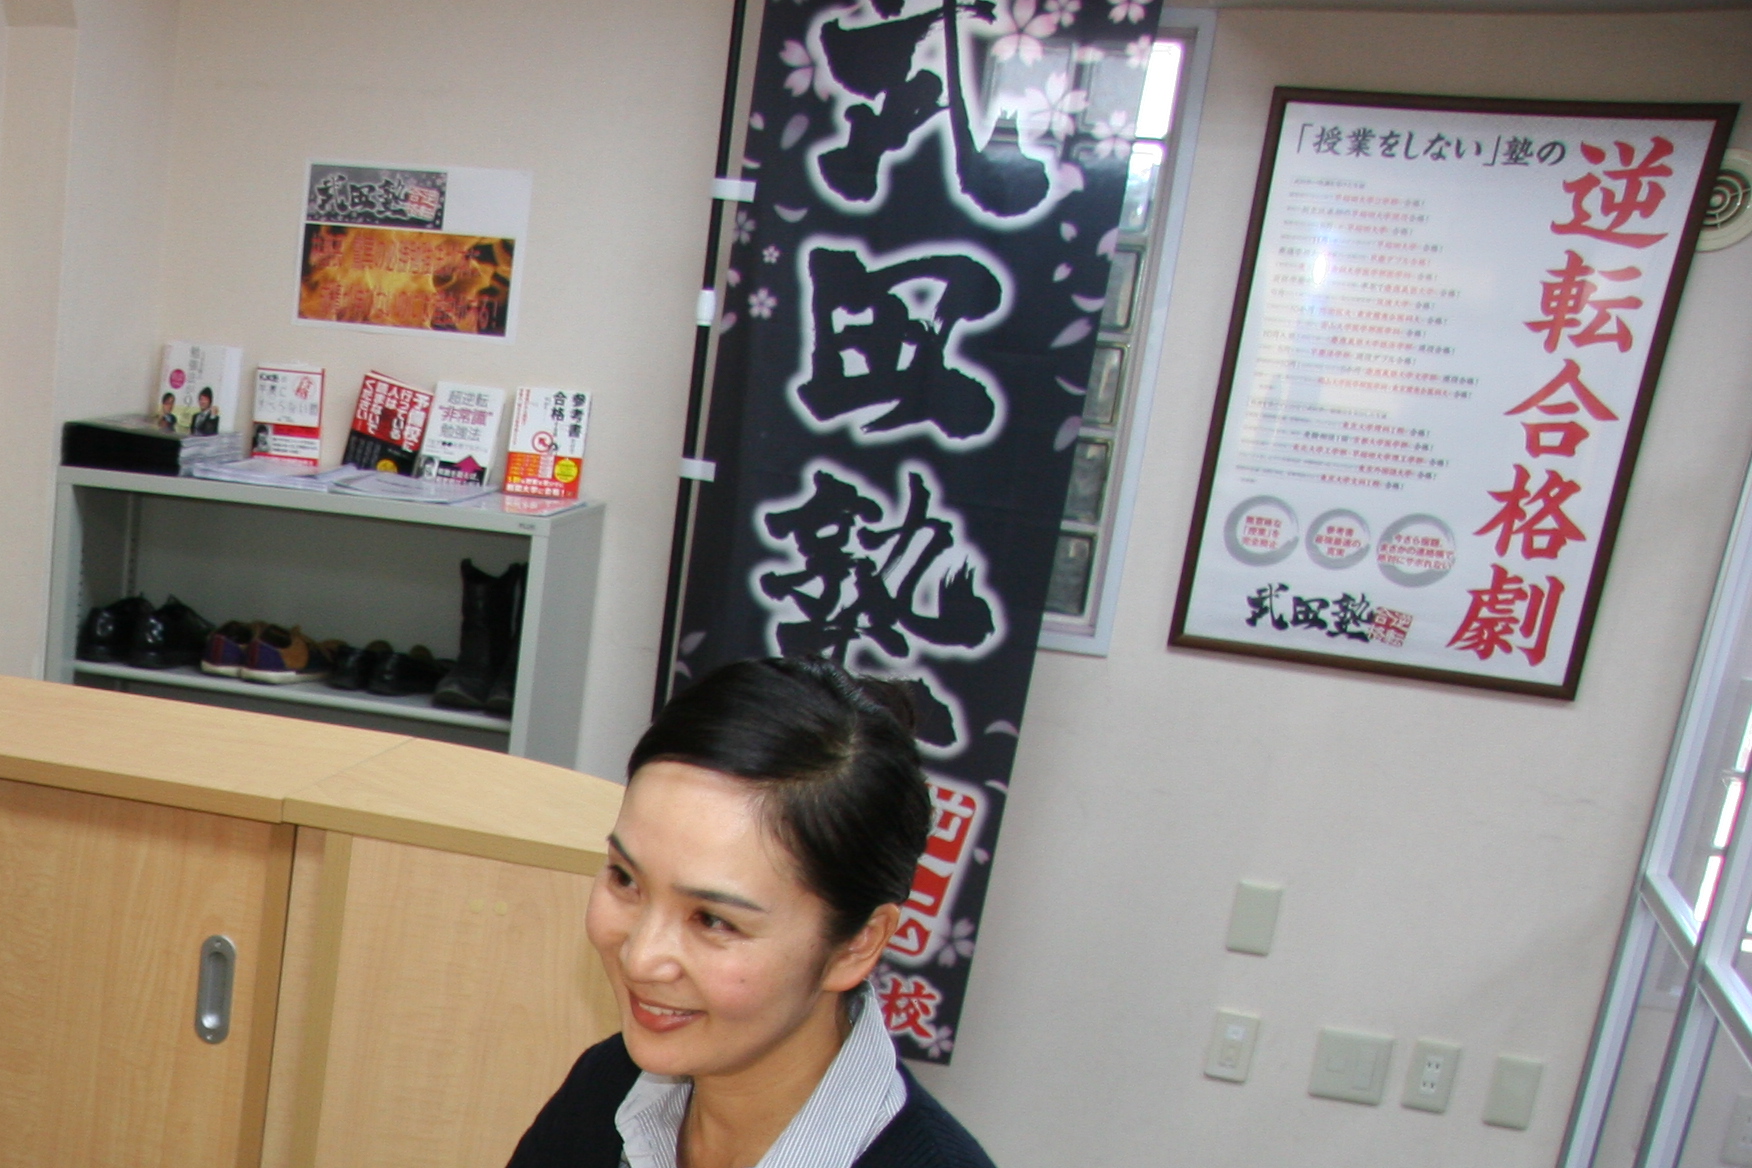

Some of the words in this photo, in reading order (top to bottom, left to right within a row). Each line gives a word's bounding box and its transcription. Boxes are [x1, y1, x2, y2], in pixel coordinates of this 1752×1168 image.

[1296, 123, 1567, 167] 「授業をしない」塾の
[402, 393, 430, 453] 予備校に
[551, 391, 567, 421] 合格
[569, 393, 586, 438] 参考書
[1446, 136, 1675, 667] 逆転合格劇
[1245, 582, 1377, 643] 武田塾
